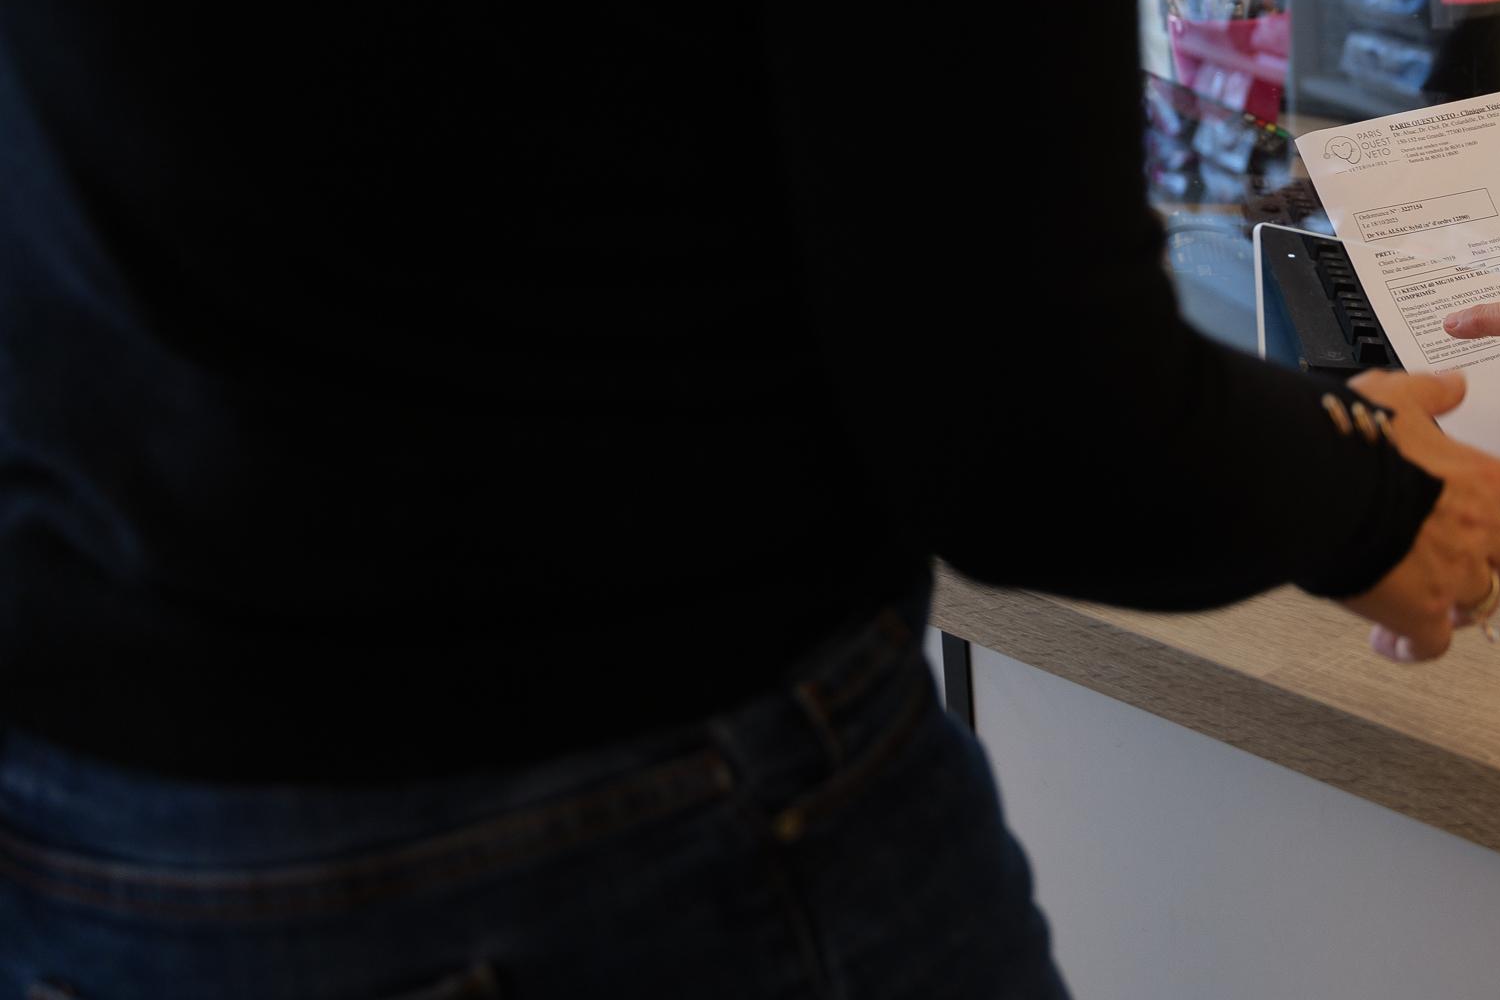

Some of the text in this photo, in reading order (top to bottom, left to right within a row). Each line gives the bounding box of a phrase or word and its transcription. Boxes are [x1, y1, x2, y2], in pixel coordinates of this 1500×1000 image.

[1389, 122, 1411, 131] PARIS
[1411, 117, 1435, 127] OUEST
[1435, 113, 1456, 122] VETO
[1460, 108, 1486, 117] Clinique
[1356, 129, 1383, 142] PARIS
[1360, 136, 1391, 150] OUEST
[1365, 147, 1391, 160] VETO
